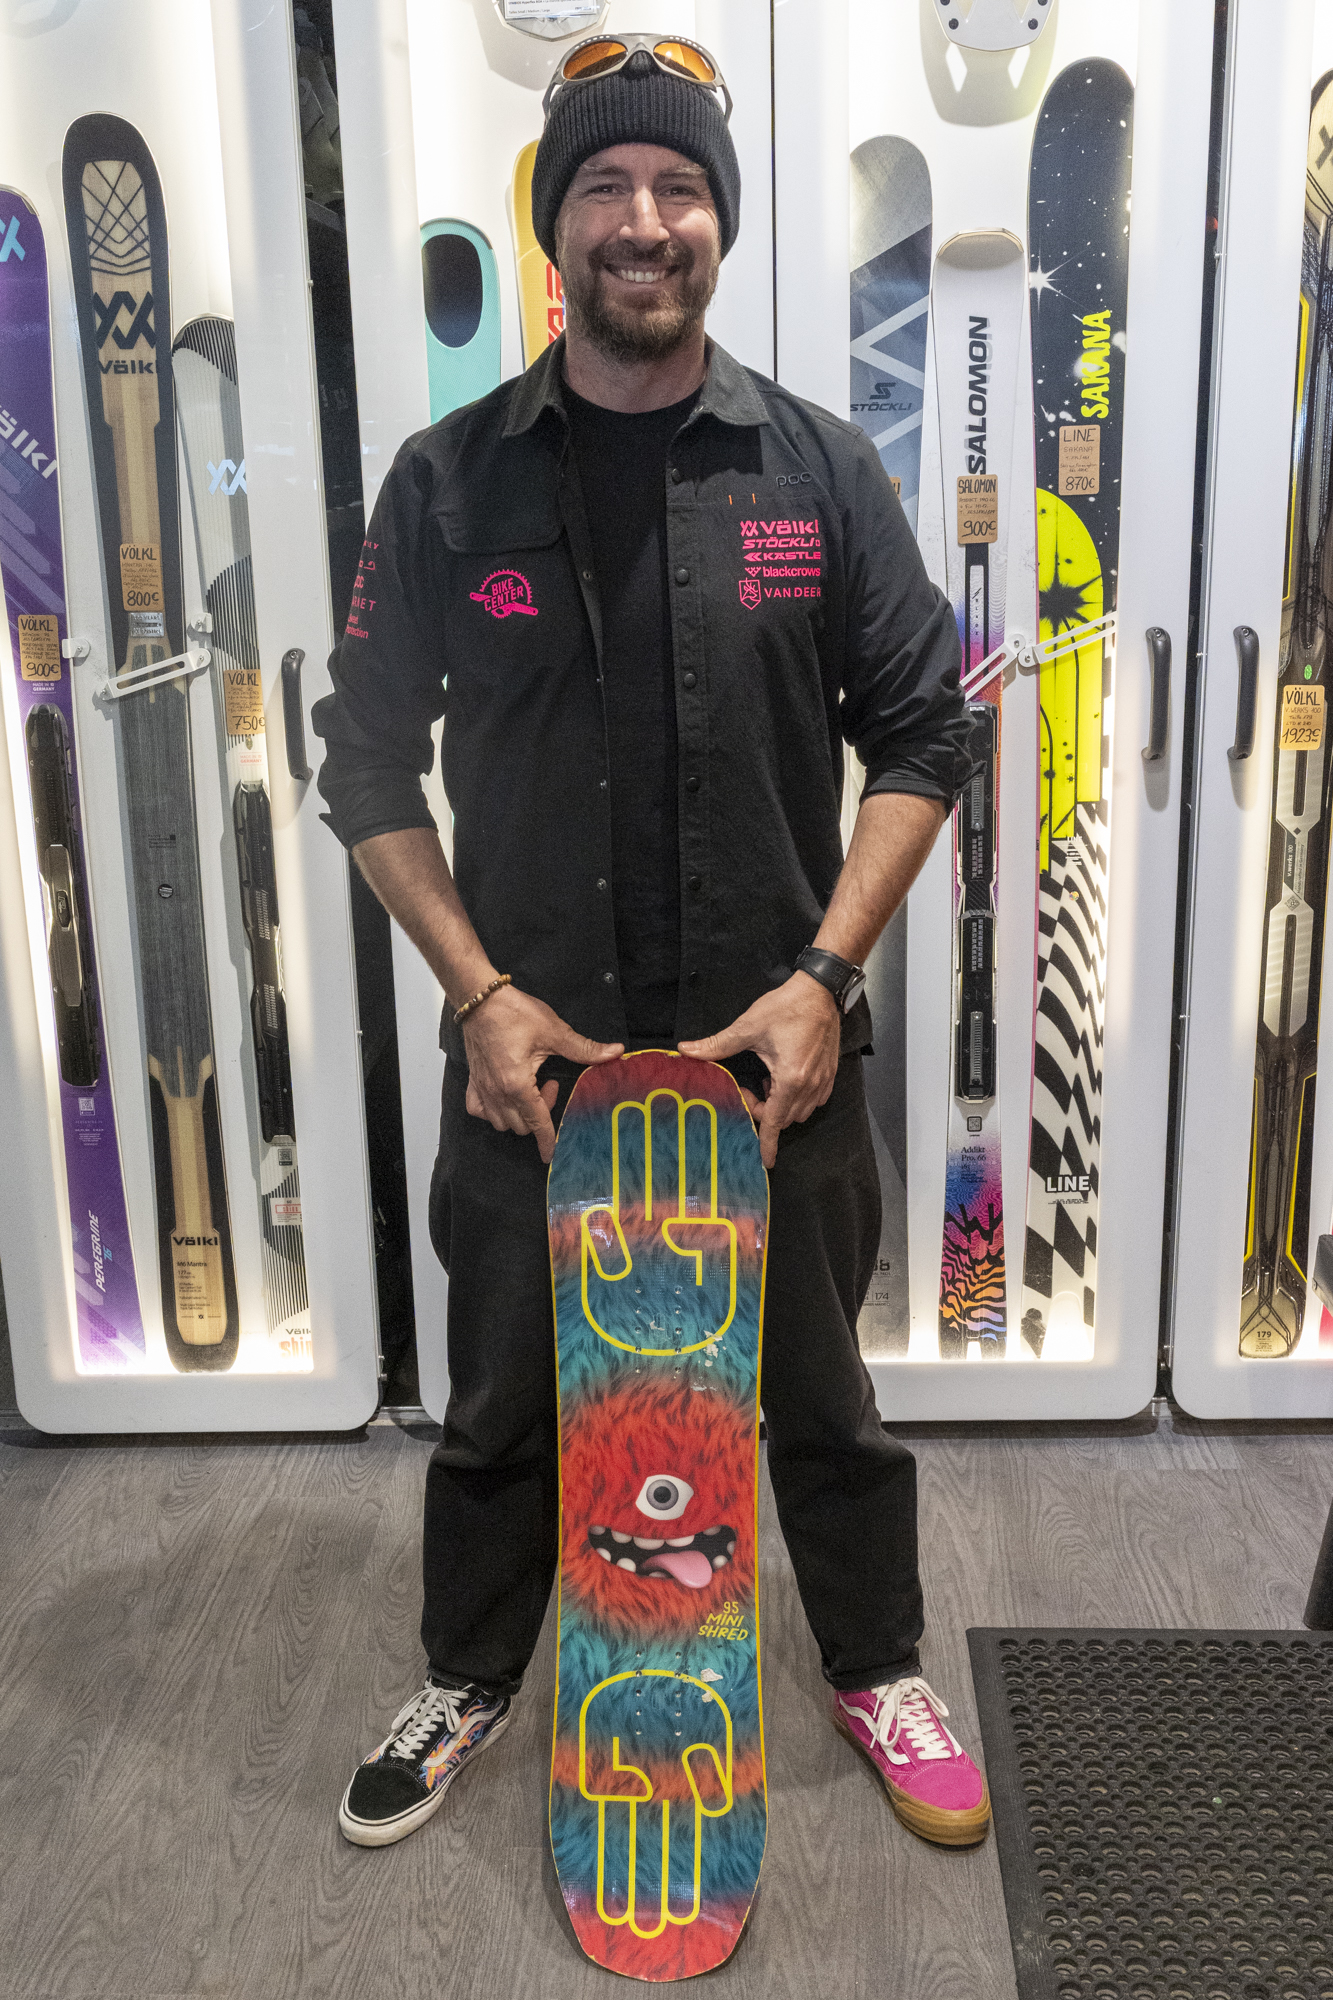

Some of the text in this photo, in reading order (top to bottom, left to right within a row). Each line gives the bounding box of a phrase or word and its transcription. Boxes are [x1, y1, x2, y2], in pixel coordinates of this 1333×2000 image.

[1081, 309, 1112, 419] SAKANA
[968, 315, 988, 475] SALOMON
[850, 401, 913, 412] STÖCKLI
[1063, 427, 1097, 442] LINE
[958, 479, 997, 494] SALOMON
[1065, 475, 1096, 491] 870€
[759, 519, 819, 535] Völkl
[961, 520, 997, 538] 900€
[742, 536, 815, 550] STÖCKLI
[121, 545, 157, 561] VÖLKL
[762, 565, 821, 578] blackcrows
[491, 577, 514, 596] BIKE
[764, 587, 821, 598] VAN DEER
[127, 590, 160, 607] 800€
[484, 585, 524, 612] CENTER
[20, 615, 54, 632] VÖLKL
[26, 662, 60, 677] 900€
[229, 671, 260, 687] VÖLKL
[1286, 687, 1321, 706] VÖLKL
[231, 715, 266, 731] 750€
[1281, 727, 1321, 744] 1923€
[1046, 1175, 1090, 1192] LINE
[172, 1236, 219, 1247] Völkl
[88, 1209, 107, 1293] PEREGRINE
[875, 1292, 889, 1300] 174
[723, 1601, 739, 1614] 95
[706, 1613, 745, 1627] MINI
[698, 1625, 749, 1641] SHRED
